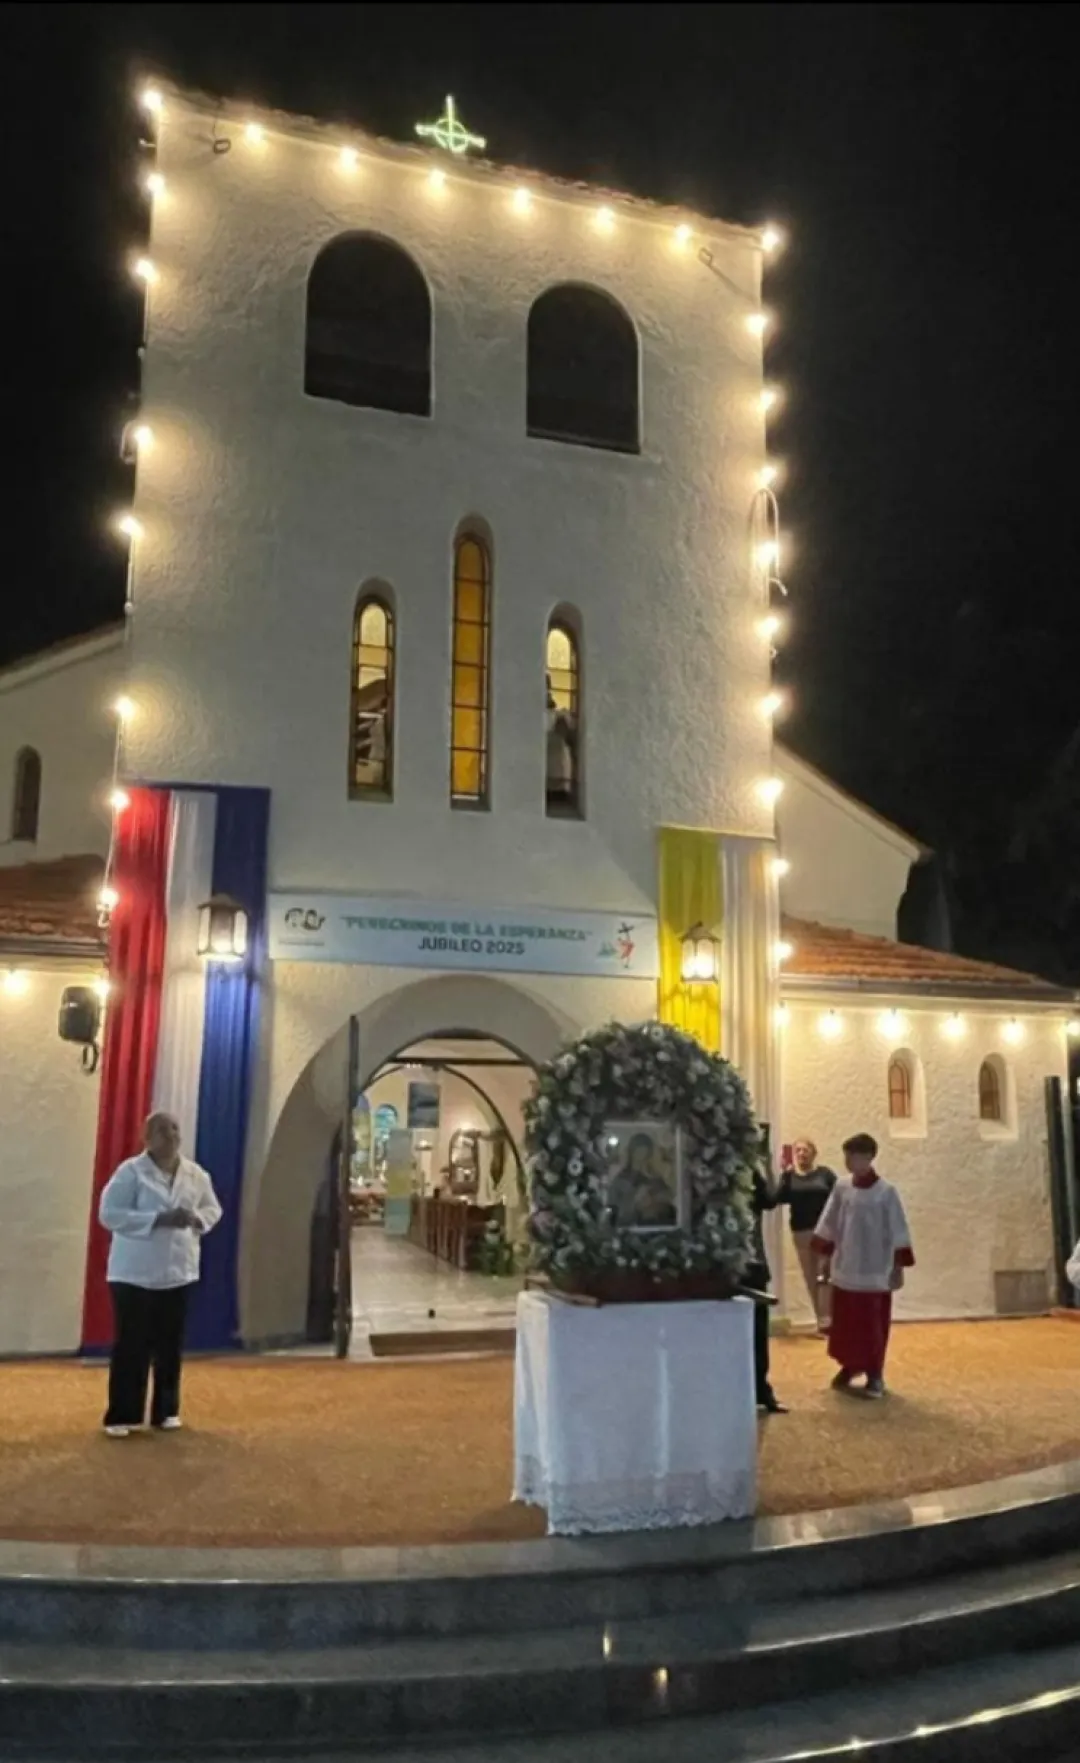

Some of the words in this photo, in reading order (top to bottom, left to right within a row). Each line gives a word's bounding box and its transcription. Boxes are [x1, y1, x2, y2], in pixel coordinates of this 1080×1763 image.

[451, 921, 471, 936] DE
[475, 922, 496, 937] LA
[418, 936, 483, 953] JUBILEO
[486, 941, 526, 955] 2025
